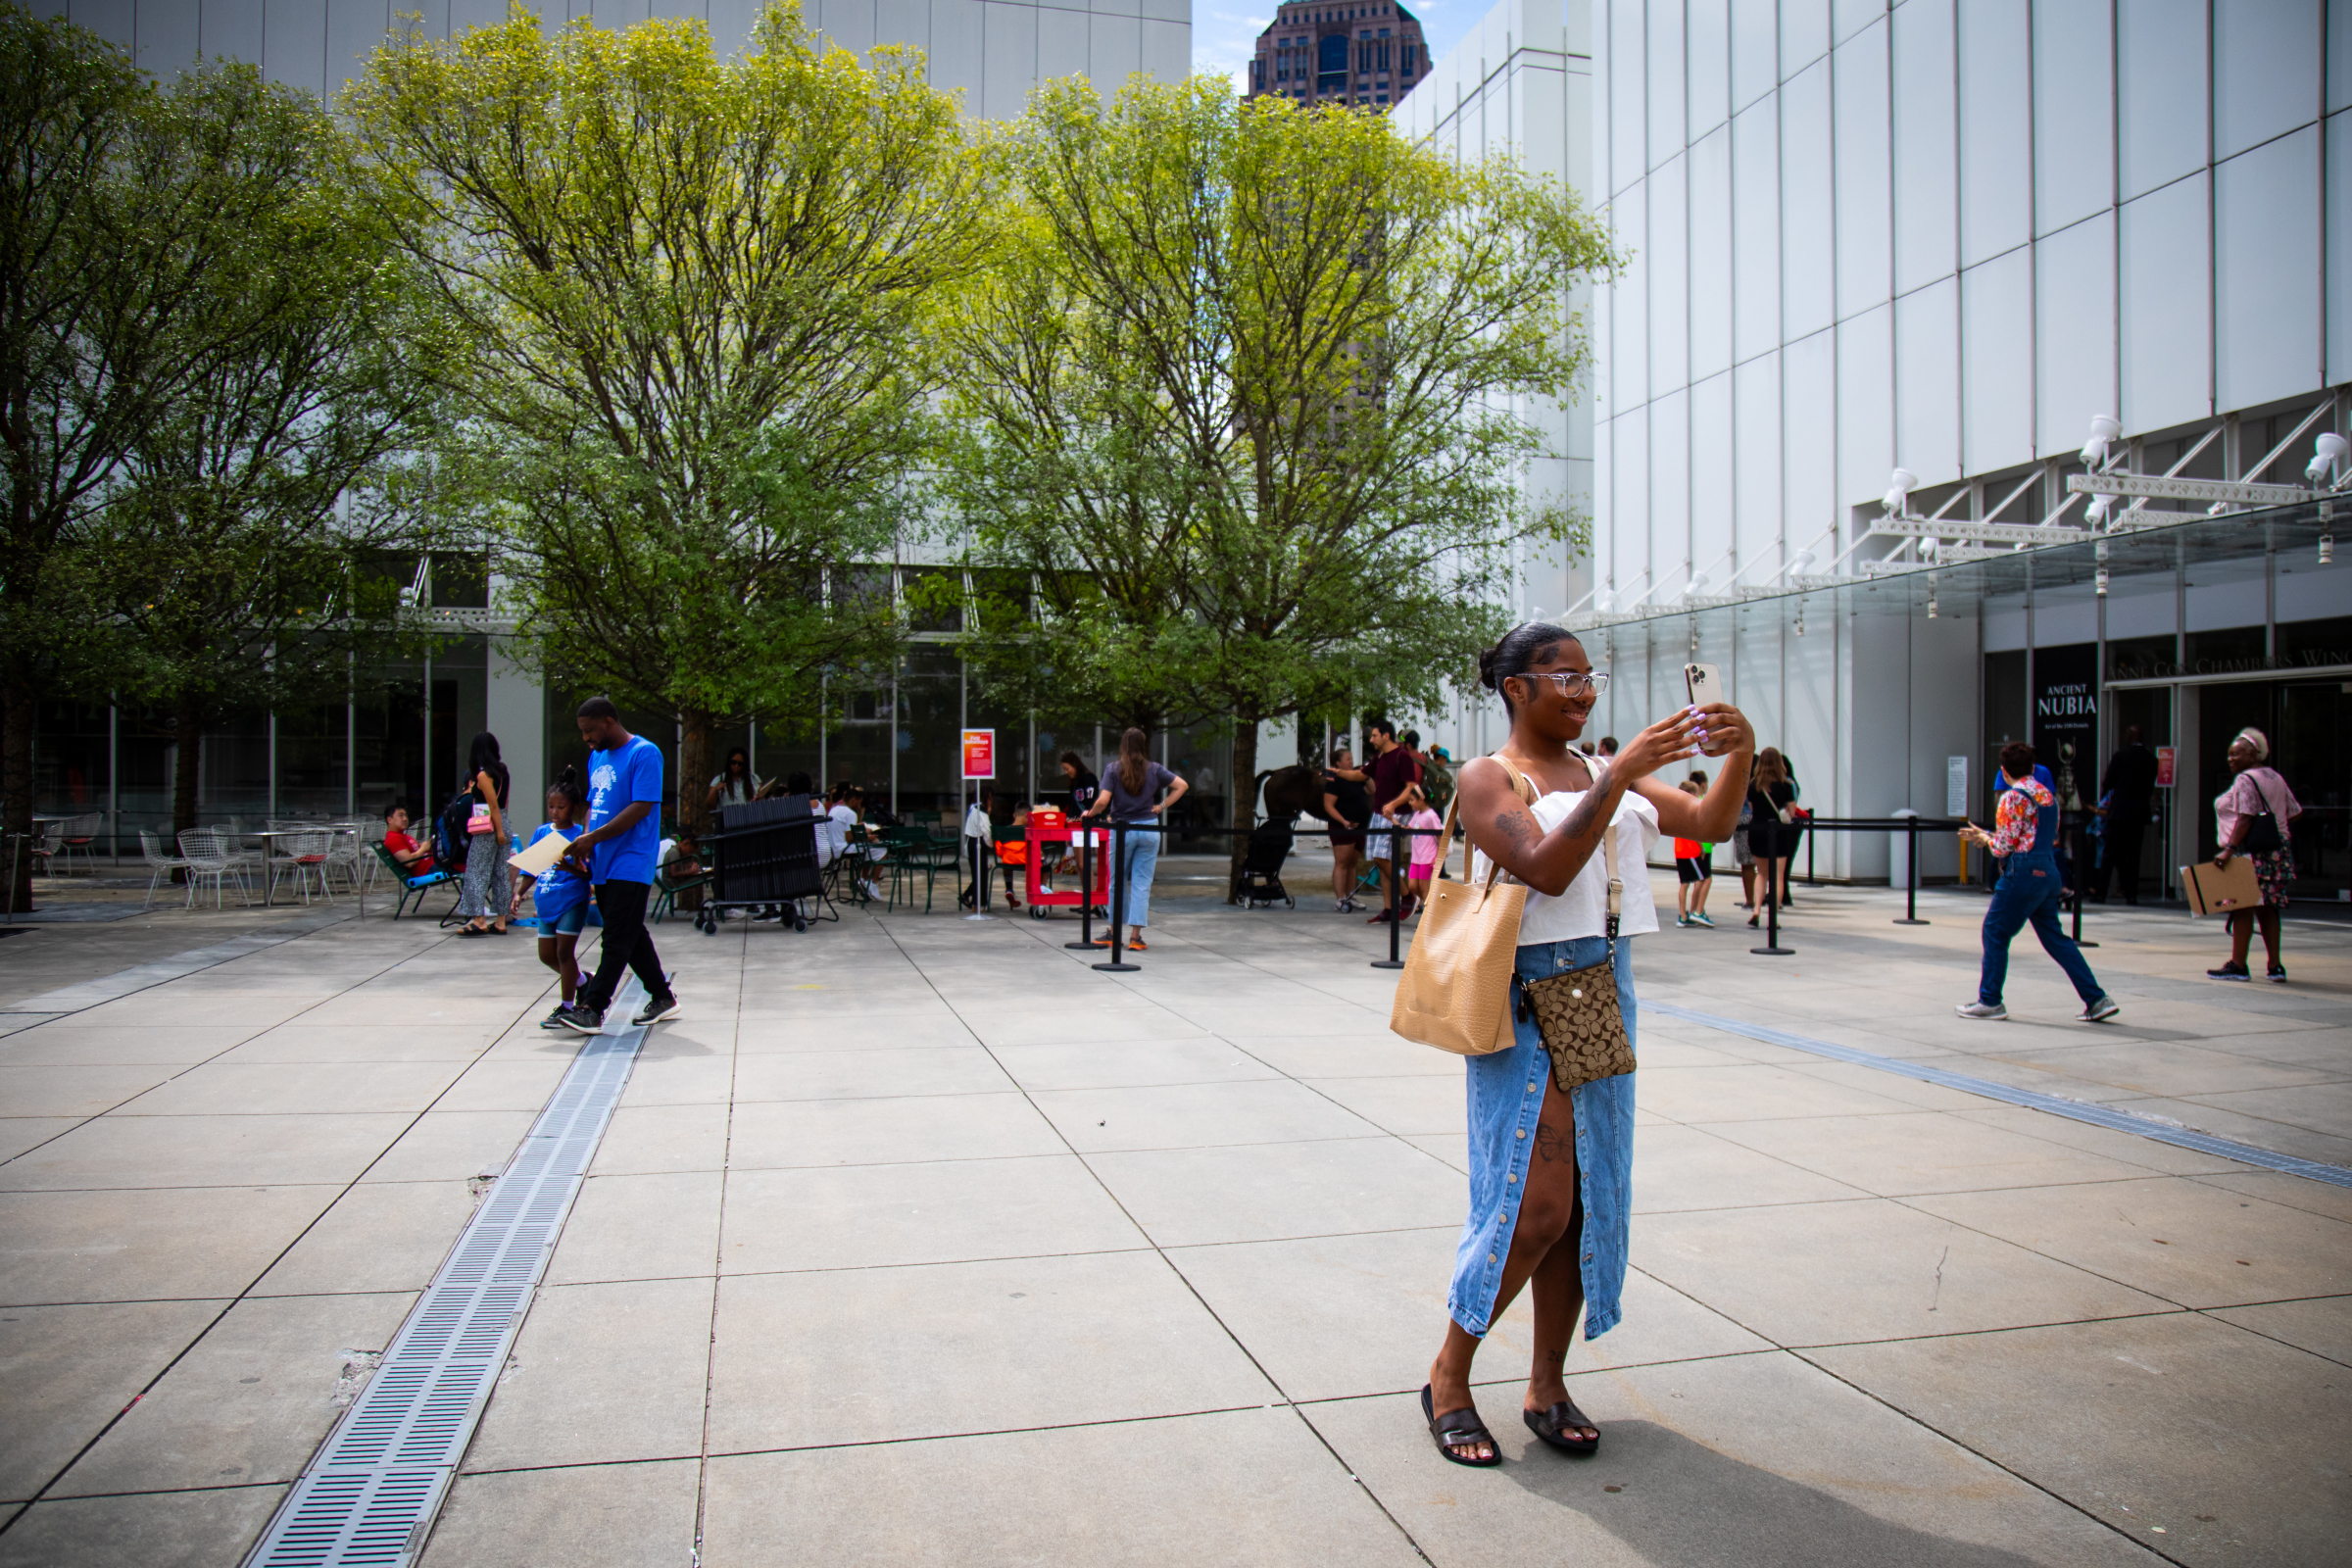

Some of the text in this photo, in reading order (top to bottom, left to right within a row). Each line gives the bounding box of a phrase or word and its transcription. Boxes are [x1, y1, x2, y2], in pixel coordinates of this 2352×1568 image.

[2154, 661, 2189, 677] COX
[2047, 682, 2087, 696] ANCIENT
[2037, 695, 2097, 716] NUBIA
[1086, 786, 1095, 799] 17
